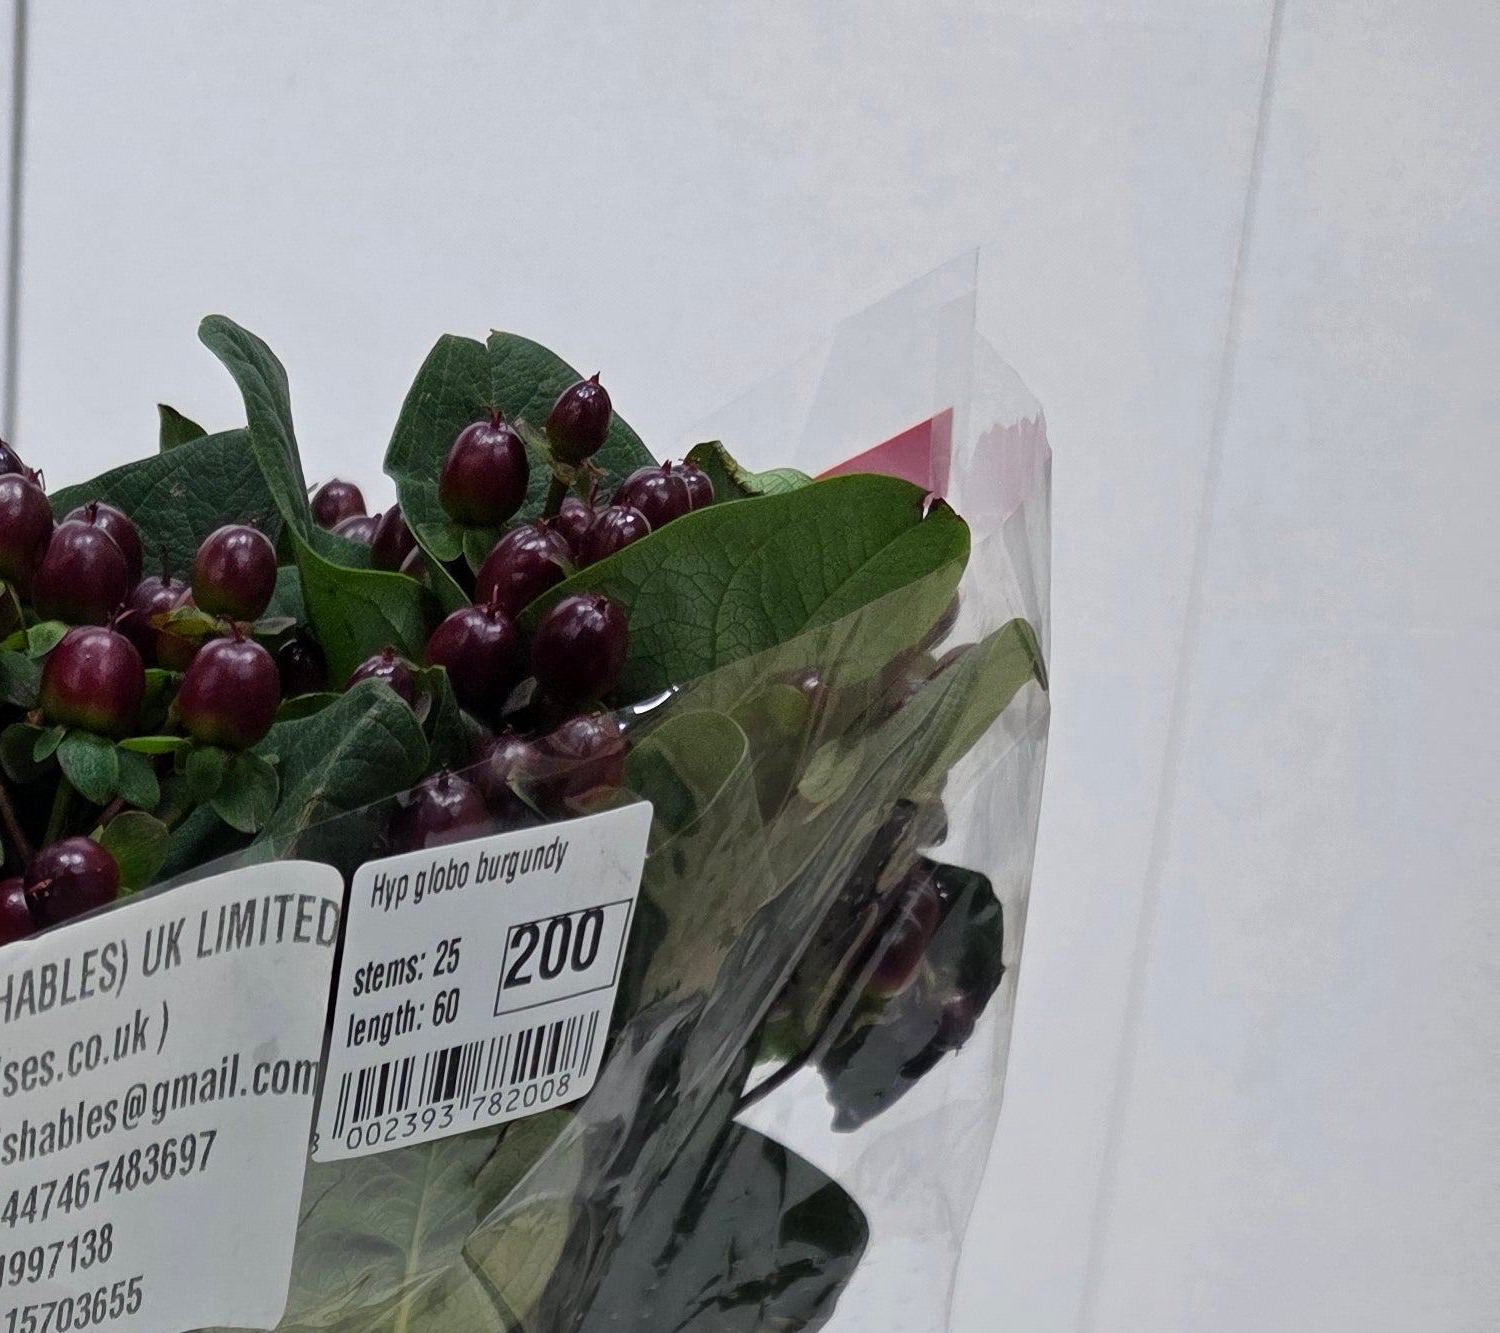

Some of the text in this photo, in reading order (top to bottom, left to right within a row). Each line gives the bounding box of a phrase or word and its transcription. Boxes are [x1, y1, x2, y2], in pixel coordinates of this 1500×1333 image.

[371, 836, 569, 912] Hyp globo burgundy
[142, 917, 187, 979] UK
[196, 894, 341, 959] LIMITED
[353, 937, 462, 998] stems: 25
[503, 905, 605, 990] 200
[347, 988, 461, 1049] length: 60
[347, 1105, 454, 1150] 002393
[472, 1073, 572, 1122] 782008
